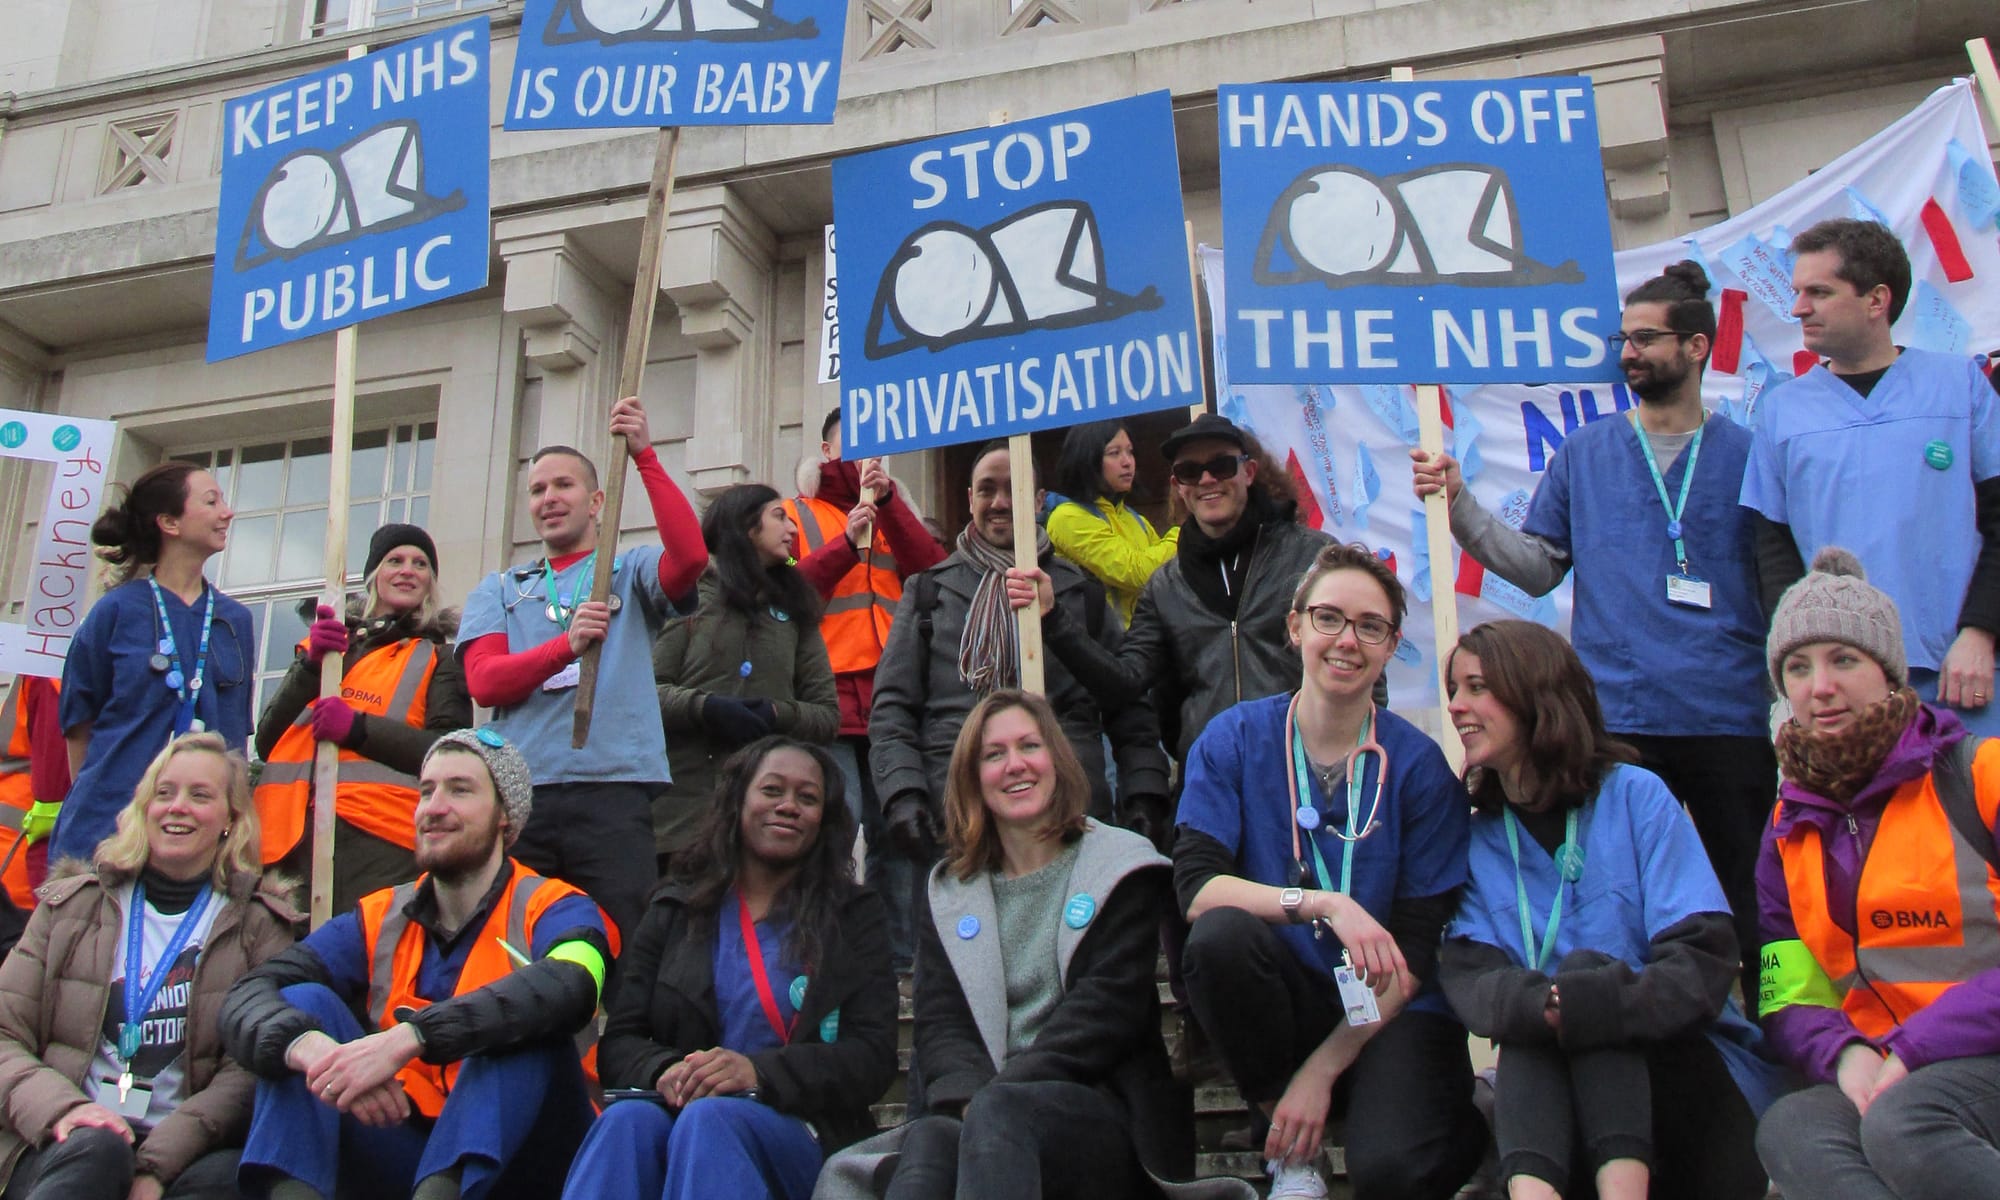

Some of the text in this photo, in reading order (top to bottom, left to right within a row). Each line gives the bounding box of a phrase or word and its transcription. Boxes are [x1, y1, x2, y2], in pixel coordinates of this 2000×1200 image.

[232, 30, 479, 157] KEEP NHS
[514, 61, 831, 119] IS OUR BABY
[1227, 88, 1586, 147] HANDS OFF
[908, 121, 1092, 209] STOP
[240, 234, 452, 344] PUBLIC
[1237, 308, 1606, 369] THE NHS
[848, 331, 1194, 448] PRIVATISATION
[25, 446, 102, 659] Hackney
[355, 689, 382, 707] BMA
[1896, 910, 1950, 929] BMA
[1761, 952, 1781, 969] MA
